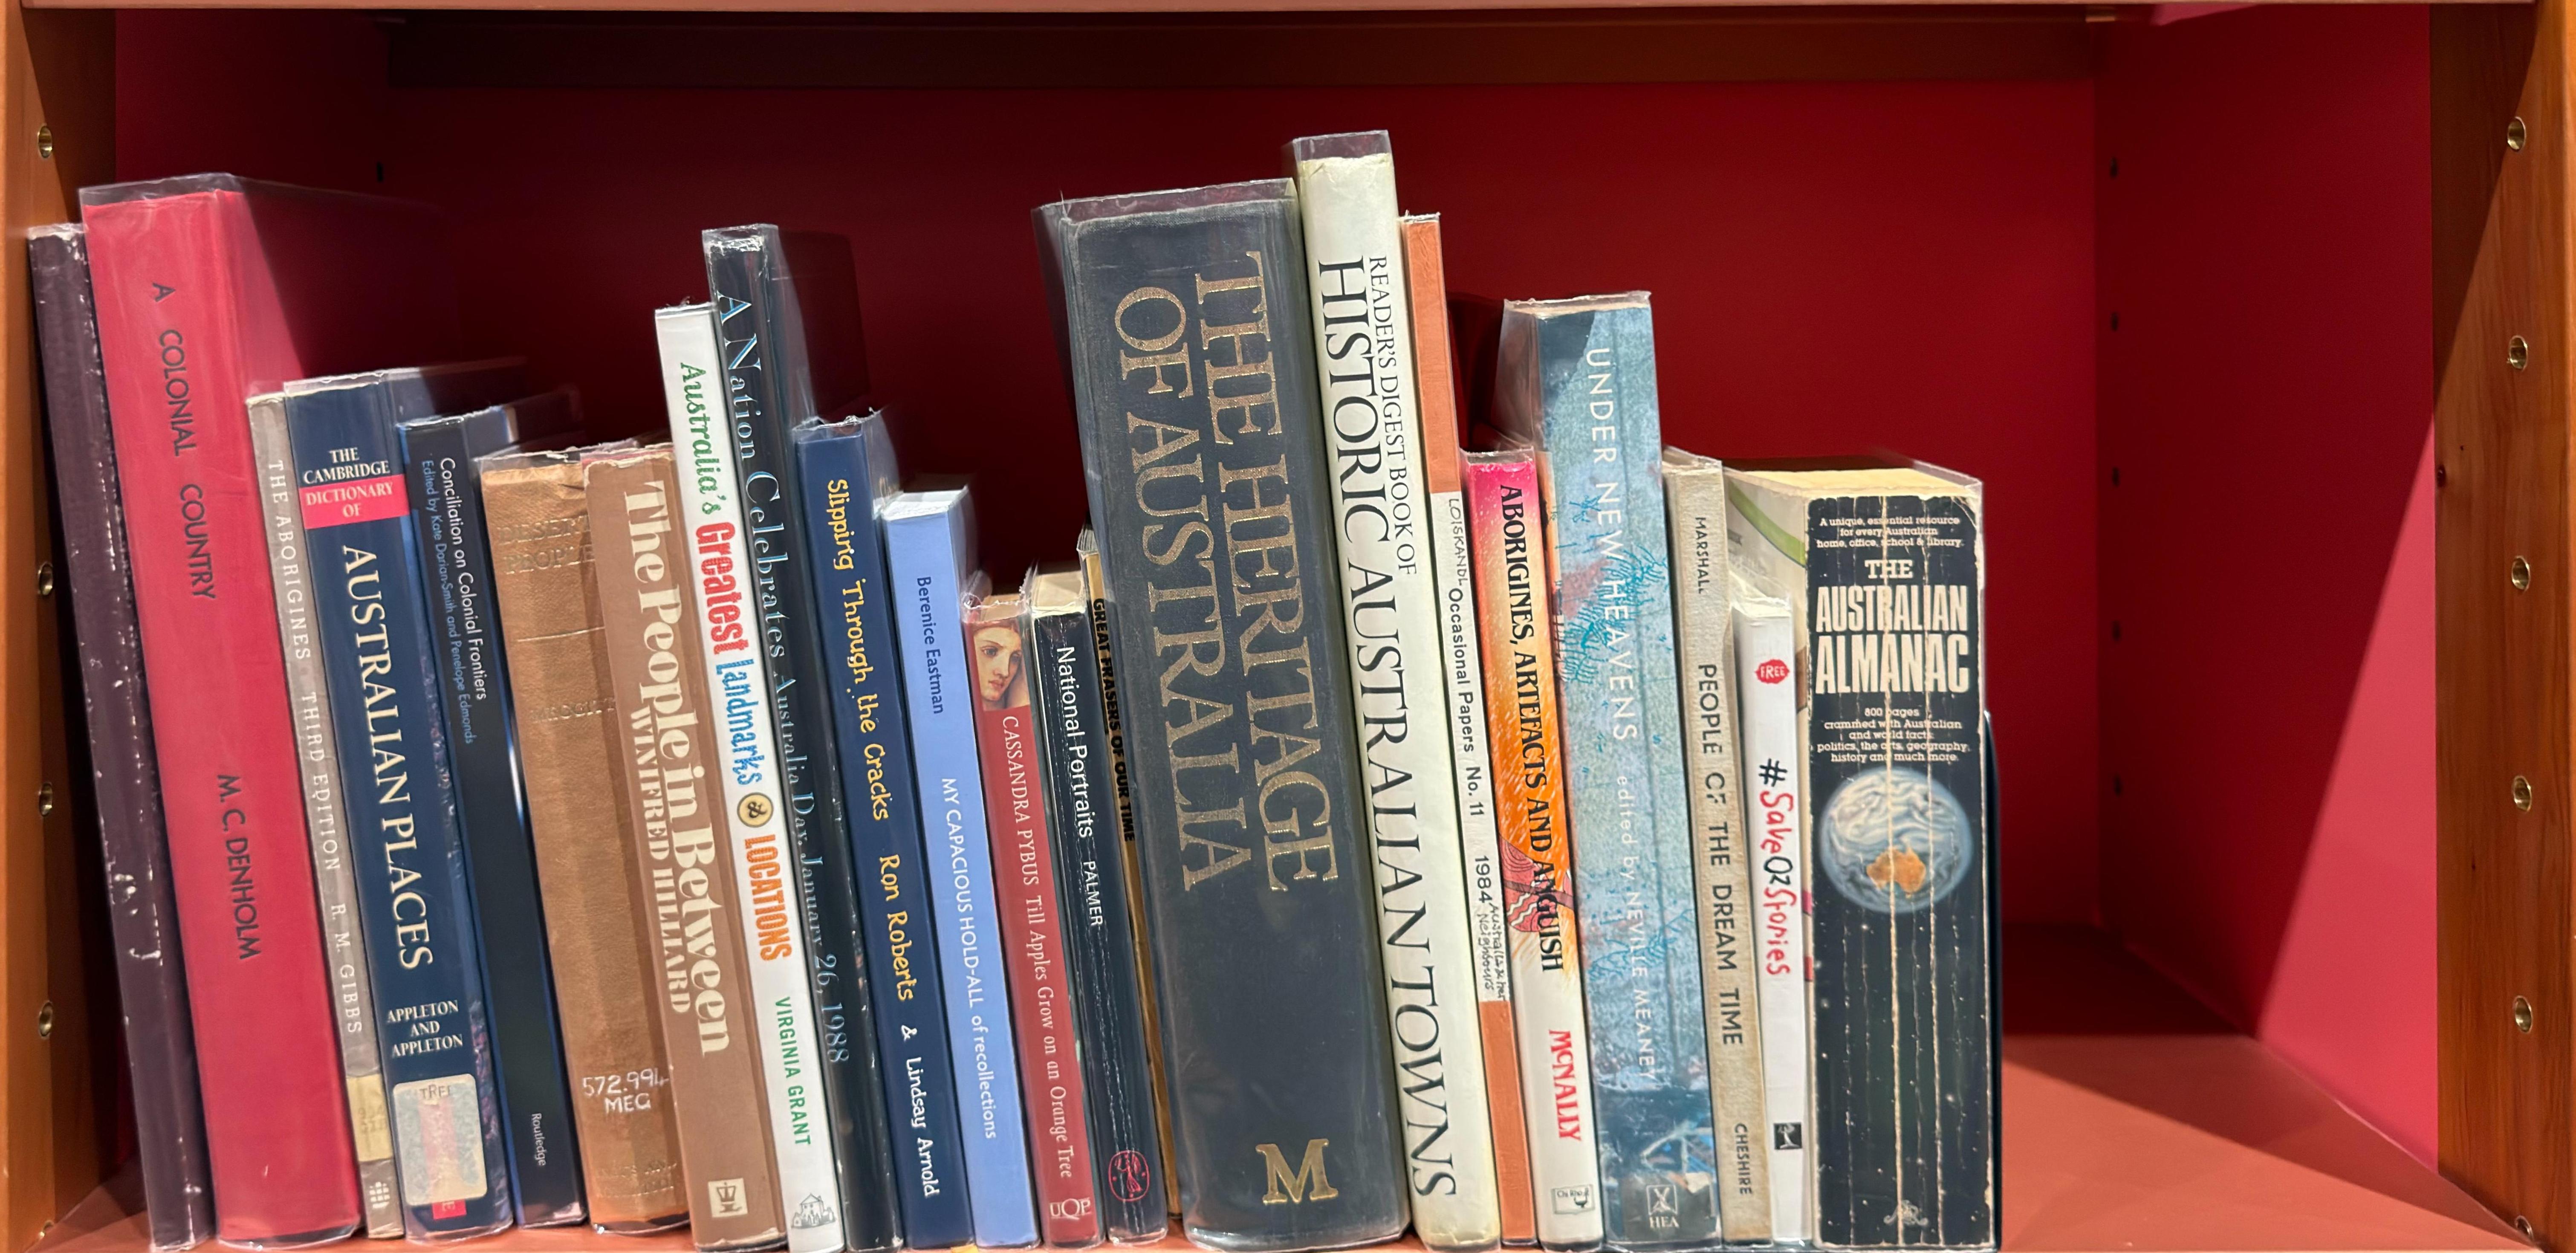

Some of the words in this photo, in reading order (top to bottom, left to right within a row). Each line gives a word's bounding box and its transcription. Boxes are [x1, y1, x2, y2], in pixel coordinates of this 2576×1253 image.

[153, 282, 176, 303] A
[717, 290, 752, 325] A
[1368, 255, 1399, 370] READER'S
[1115, 286, 1194, 399] OF
[1195, 251, 1282, 445] THE
[158, 329, 197, 457] COLONIAL
[724, 333, 761, 461] Nation
[1318, 255, 1394, 544] HISTORIC
[1379, 375, 1406, 460] DIGEST
[1586, 348, 1617, 463] UNDER
[330, 447, 360, 463] THE
[681, 362, 726, 515] Australia's
[269, 460, 289, 504] THE
[304, 461, 390, 483] CAMBRIDGE
[306, 482, 393, 506] DICTIONARY
[421, 460, 435, 495] Edited
[440, 457, 463, 545] Conciliation
[1389, 465, 1414, 538] BOOK
[342, 504, 361, 518] OF
[426, 498, 439, 512] by
[431, 515, 442, 541] Kate
[624, 480, 671, 584] The
[827, 479, 855, 570] Slipping
[1595, 482, 1625, 559] NEW
[1819, 518, 1828, 526] A
[1829, 518, 1865, 527] unique,
[1840, 528, 1853, 536] for
[1856, 528, 1882, 537] every
[1886, 527, 1938, 535] Australian
[179, 483, 216, 599] COUNTRY
[454, 550, 466, 568] on
[746, 472, 790, 658] Celebrates
[1396, 543, 1417, 575] OF
[1500, 484, 1535, 645] ABORIGINES,
[1695, 516, 1710, 594] MARSHALL
[1816, 539, 1847, 548] home,
[1865, 559, 1913, 579] THE
[277, 515, 310, 659] ABORIGINES
[435, 543, 453, 613] Darian-Smith
[458, 572, 482, 634] Colonial
[696, 522, 749, 655] Greatest
[1816, 585, 1968, 632] AUSTRALIAN
[447, 616, 461, 638] and
[843, 580, 873, 684] Through
[917, 576, 936, 645] Berenice
[1093, 598, 1110, 651] GREAT
[1448, 587, 1471, 685] Occasional
[451, 640, 465, 691] Penelope
[468, 638, 487, 700] Frontiers
[638, 584, 698, 759] People
[925, 648, 943, 715] Eastman
[1127, 411, 1252, 892] AUSTRALIA
[1218, 454, 1339, 893] HERITAGE
[1602, 579, 1638, 741] HEAVENS
[1761, 664, 1785, 679] FREE
[1815, 634, 1969, 694] ALMANAC
[459, 694, 477, 744] Edmonds
[716, 659, 765, 786] Landmarks
[857, 694, 879, 734] the
[1057, 646, 1086, 737] National
[1101, 657, 1121, 732] FRASERS
[1458, 691, 1474, 753] Papers
[1514, 650, 1548, 790] ARTEFACTS
[1698, 664, 1723, 754] PEOPLE
[1865, 708, 1883, 717] 800
[302, 692, 325, 762] THIRD
[774, 670, 807, 785] Australia
[1110, 735, 1125, 758] OF
[1824, 720, 1876, 729] crammed
[1849, 730, 1871, 739] and
[1860, 742, 1878, 750] the
[343, 545, 411, 804] AUSTRALIAN
[382, 813, 434, 969] PLACES
[864, 743, 893, 822] Cracks
[1114, 761, 1130, 799] OUR
[1347, 558, 1431, 955] AUSTRALIAN
[1465, 766, 1482, 797] No.
[1831, 753, 1867, 763] history
[1894, 752, 1925, 761] much
[218, 774, 242, 804] M.
[663, 764, 705, 824] in
[942, 778, 960, 805] MY
[1003, 715, 1030, 824] CASSANDRA
[1018, 829, 1039, 885] PYBUS
[1069, 744, 1096, 838] Portraits
[1470, 801, 1484, 816] 11
[1617, 776, 1638, 845] edited
[223, 808, 246, 833] C.
[312, 773, 340, 870] EDITION
[1120, 802, 1135, 842] TIME
[1526, 797, 1553, 853] AND
[1708, 822, 1730, 866] THE
[631, 706, 670, 860] WINIFRED
[653, 868, 691, 1013] HILLIARD
[879, 854, 900, 901] Ron
[945, 810, 973, 912] CAPACIOUS
[1474, 856, 1492, 903] 1984
[1619, 855, 1640, 881] by
[225, 836, 261, 960] DENHOLM
[331, 903, 347, 920] R.
[744, 834, 792, 961] LOCATIONS
[1026, 895, 1045, 924] Till
[1083, 860, 1103, 926] PALMER
[1533, 859, 1564, 972] ANGUISH
[335, 932, 350, 953] M.
[673, 823, 730, 1058] Between
[887, 911, 916, 1002] Roberts
[1026, 930, 1051, 981] Apples
[1625, 891, 1648, 978] NEVILLE
[1712, 885, 1738, 971] DREAM
[960, 917, 981, 1008] HOLD-ALL
[340, 964, 362, 1033] GIBBS
[387, 1000, 459, 1023] APPLETON
[410, 1021, 440, 1037] AND
[971, 1016, 989, 1033] of
[1037, 987, 1054, 1029] Grow
[1719, 987, 1743, 1045] TIME
[392, 1035, 463, 1059] APPLETON
[775, 996, 801, 1079] VIRGINIA
[821, 1002, 849, 1063] 1988
[901, 1024, 917, 1042] &
[1044, 1036, 1056, 1054] on
[1633, 988, 1657, 1079] MEANEY
[582, 1068, 669, 1097] 572.994
[906, 1057, 927, 1129] Lindsay
[972, 1035, 997, 1140] recollections
[1047, 1061, 1059, 1079] an
[1391, 965, 1457, 1197] TOWNS
[604, 1093, 651, 1114] MEG
[787, 1085, 811, 1145] GRANT
[1049, 1086, 1067, 1142] Orange
[531, 1113, 546, 1166] Routledge
[917, 1137, 940, 1199] Arnold
[1058, 1145, 1074, 1178] Tree
[1734, 1123, 1752, 1195] CHESHIRE
[1255, 1138, 1339, 1205] M
[1049, 1197, 1091, 1221] UQP
[1649, 1216, 1680, 1229] HEA
